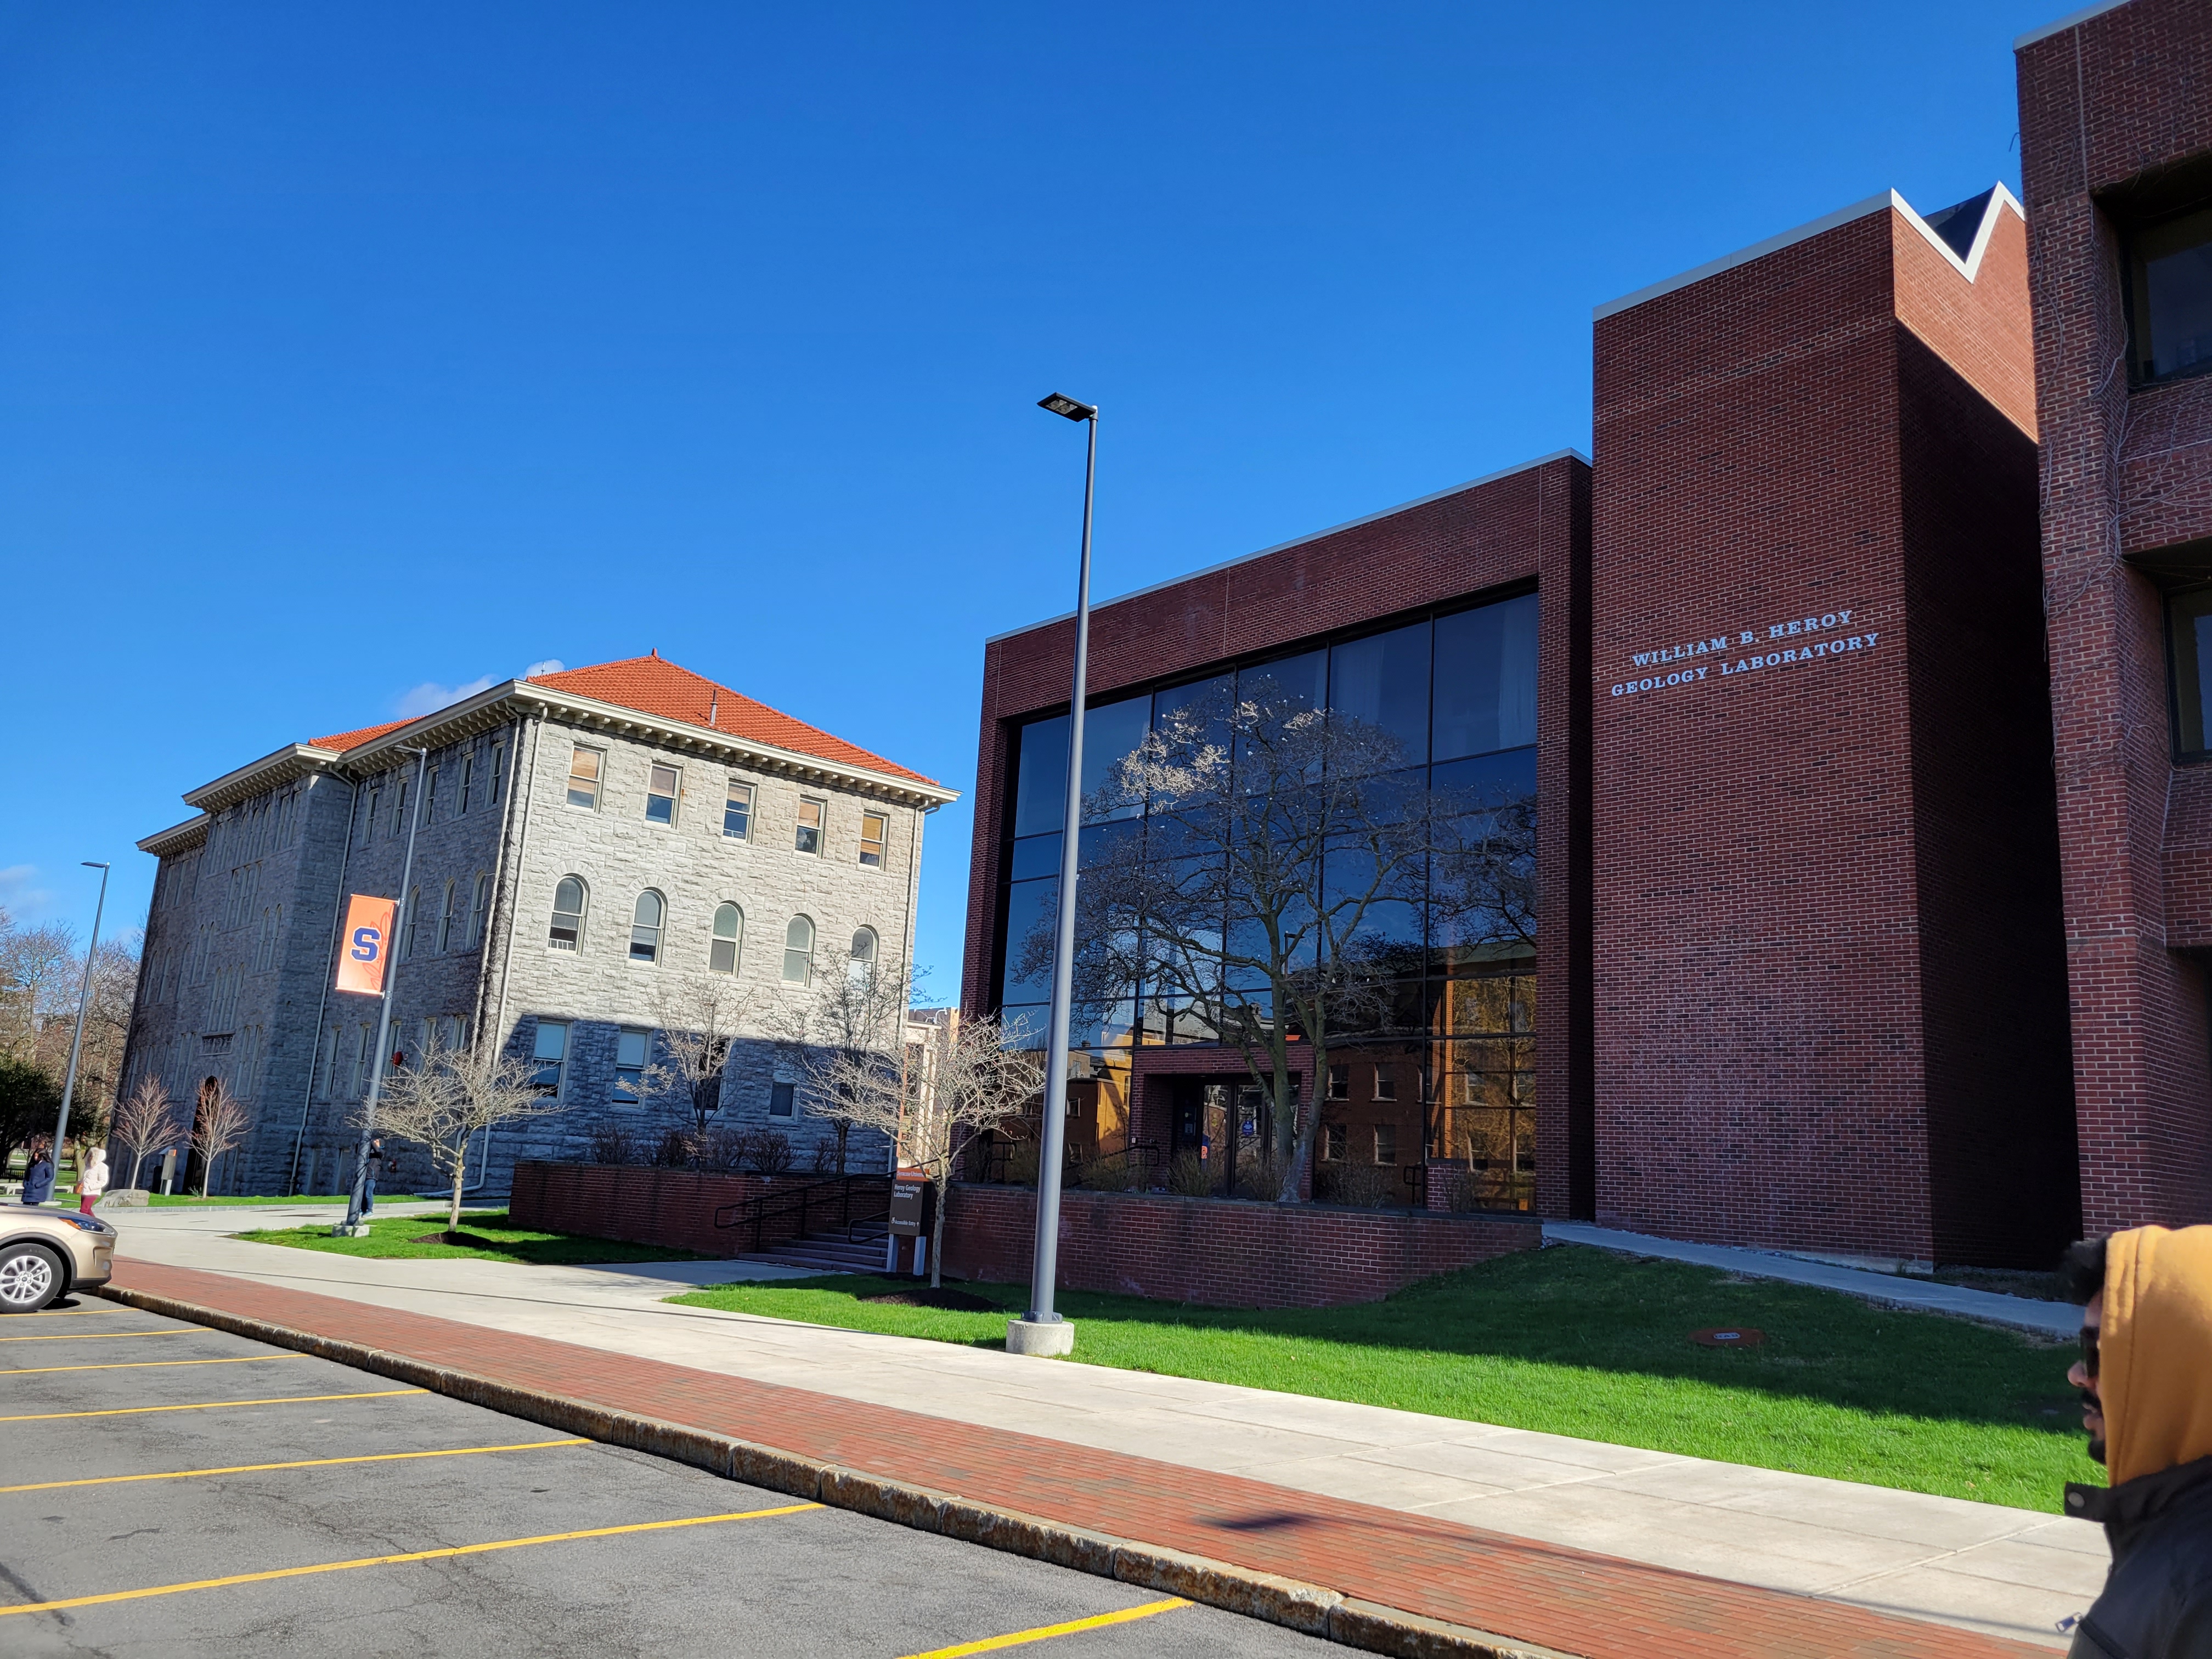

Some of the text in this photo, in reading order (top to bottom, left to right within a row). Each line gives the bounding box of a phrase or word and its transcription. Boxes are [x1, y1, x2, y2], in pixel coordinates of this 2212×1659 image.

[1632, 610, 1853, 667] WILLIAM B. HEROY
[1611, 633, 1880, 697] GEOLOGY LABORATORY
[351, 926, 381, 962] S
[894, 1184, 921, 1193] Heroy Geology
[894, 1191, 913, 1200] Laboratory
